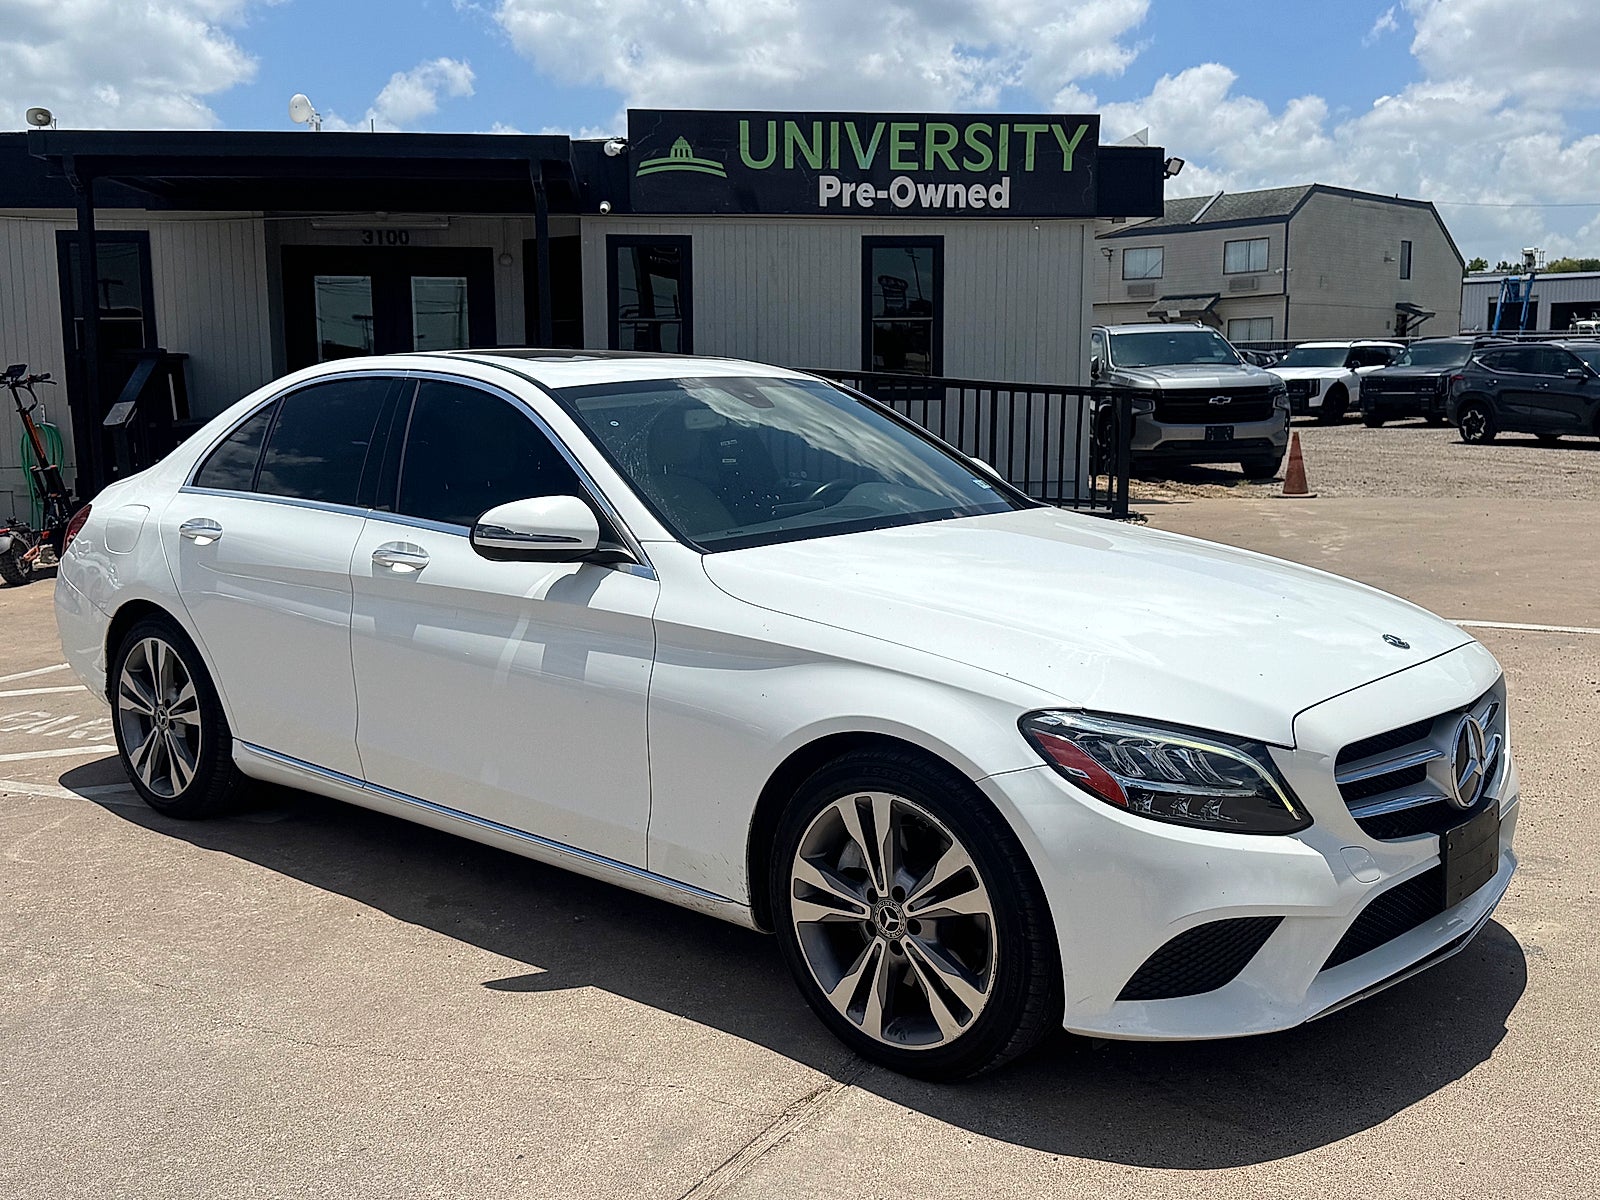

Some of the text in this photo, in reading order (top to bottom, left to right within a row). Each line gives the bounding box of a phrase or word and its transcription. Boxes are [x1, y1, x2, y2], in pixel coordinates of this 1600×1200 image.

[739, 120, 1089, 172] UNIVERSITY
[819, 176, 1010, 208] Pre-Owned
[362, 229, 410, 245] 3100
